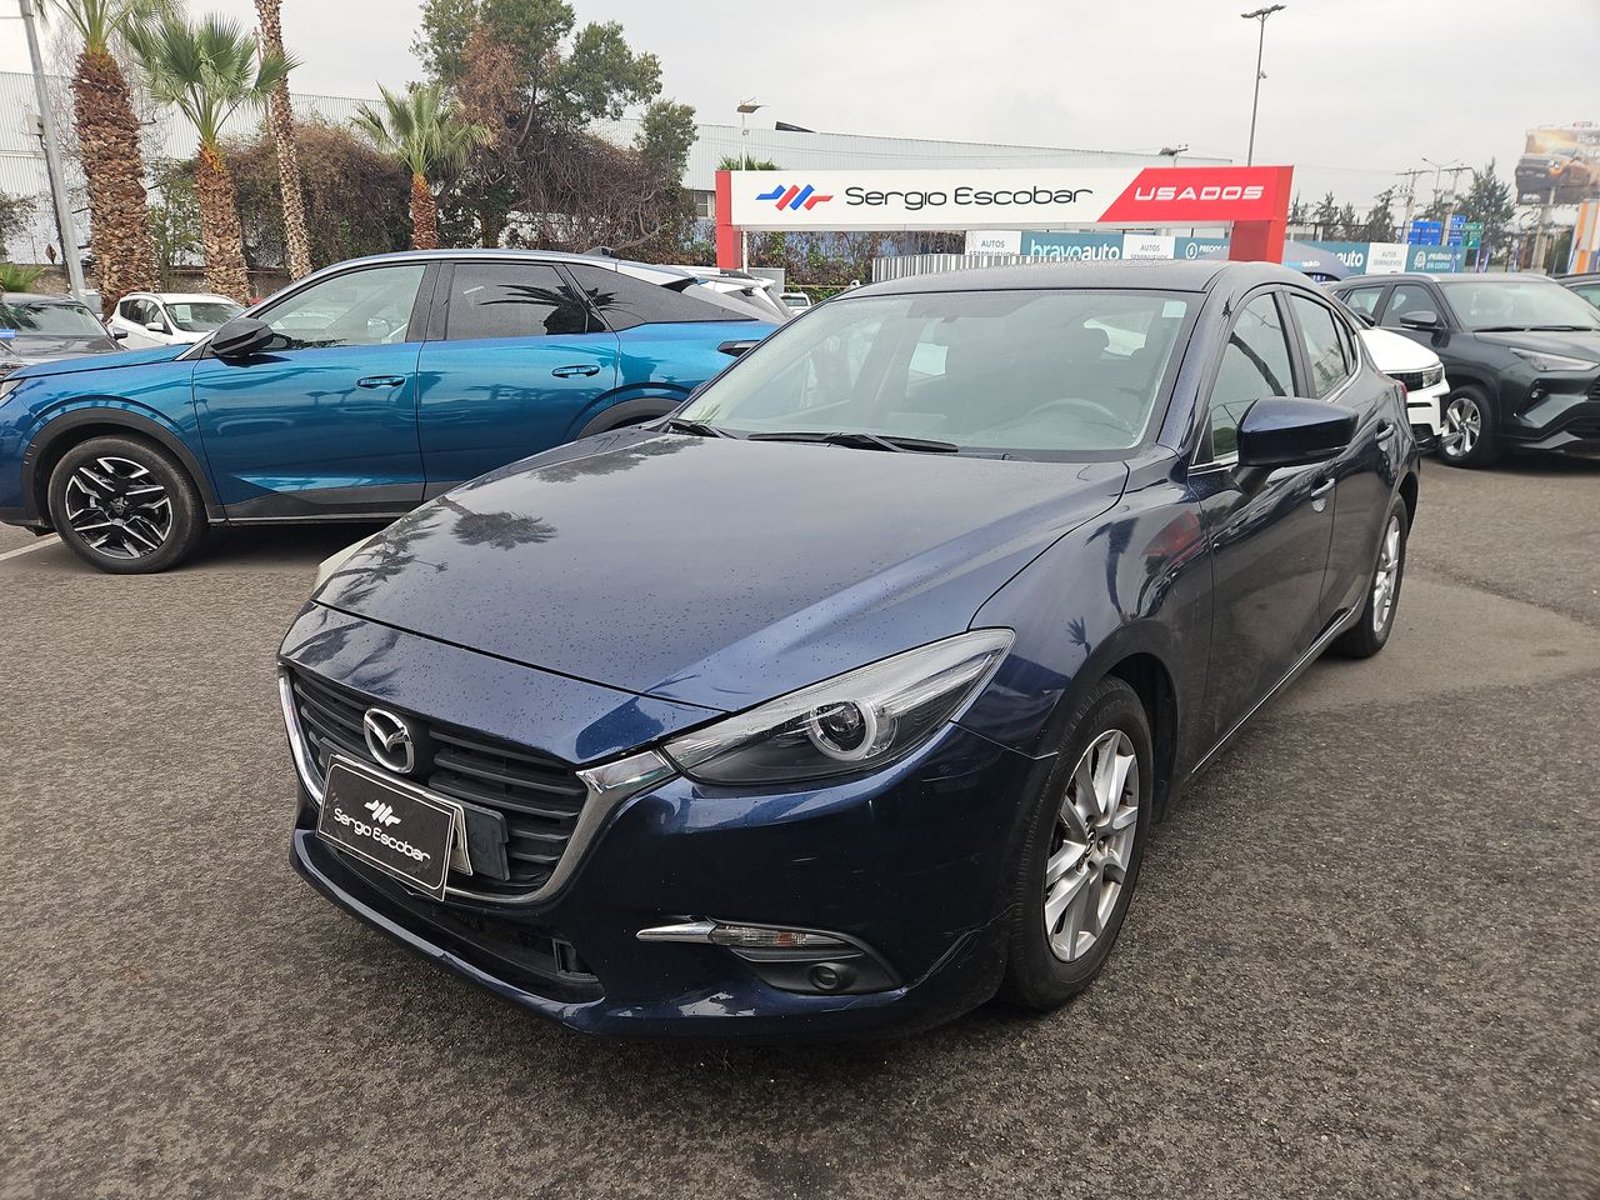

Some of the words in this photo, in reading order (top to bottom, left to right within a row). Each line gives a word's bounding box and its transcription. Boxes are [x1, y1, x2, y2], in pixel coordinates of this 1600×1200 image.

[845, 186, 948, 211] Sergio
[954, 185, 1094, 206] Escobar
[1134, 185, 1265, 201] USADOS
[980, 240, 1005, 248] AUTOS
[1030, 239, 1121, 261] bravoauto
[1139, 244, 1161, 253] AUTOS
[372, 826, 431, 862] Escobar
